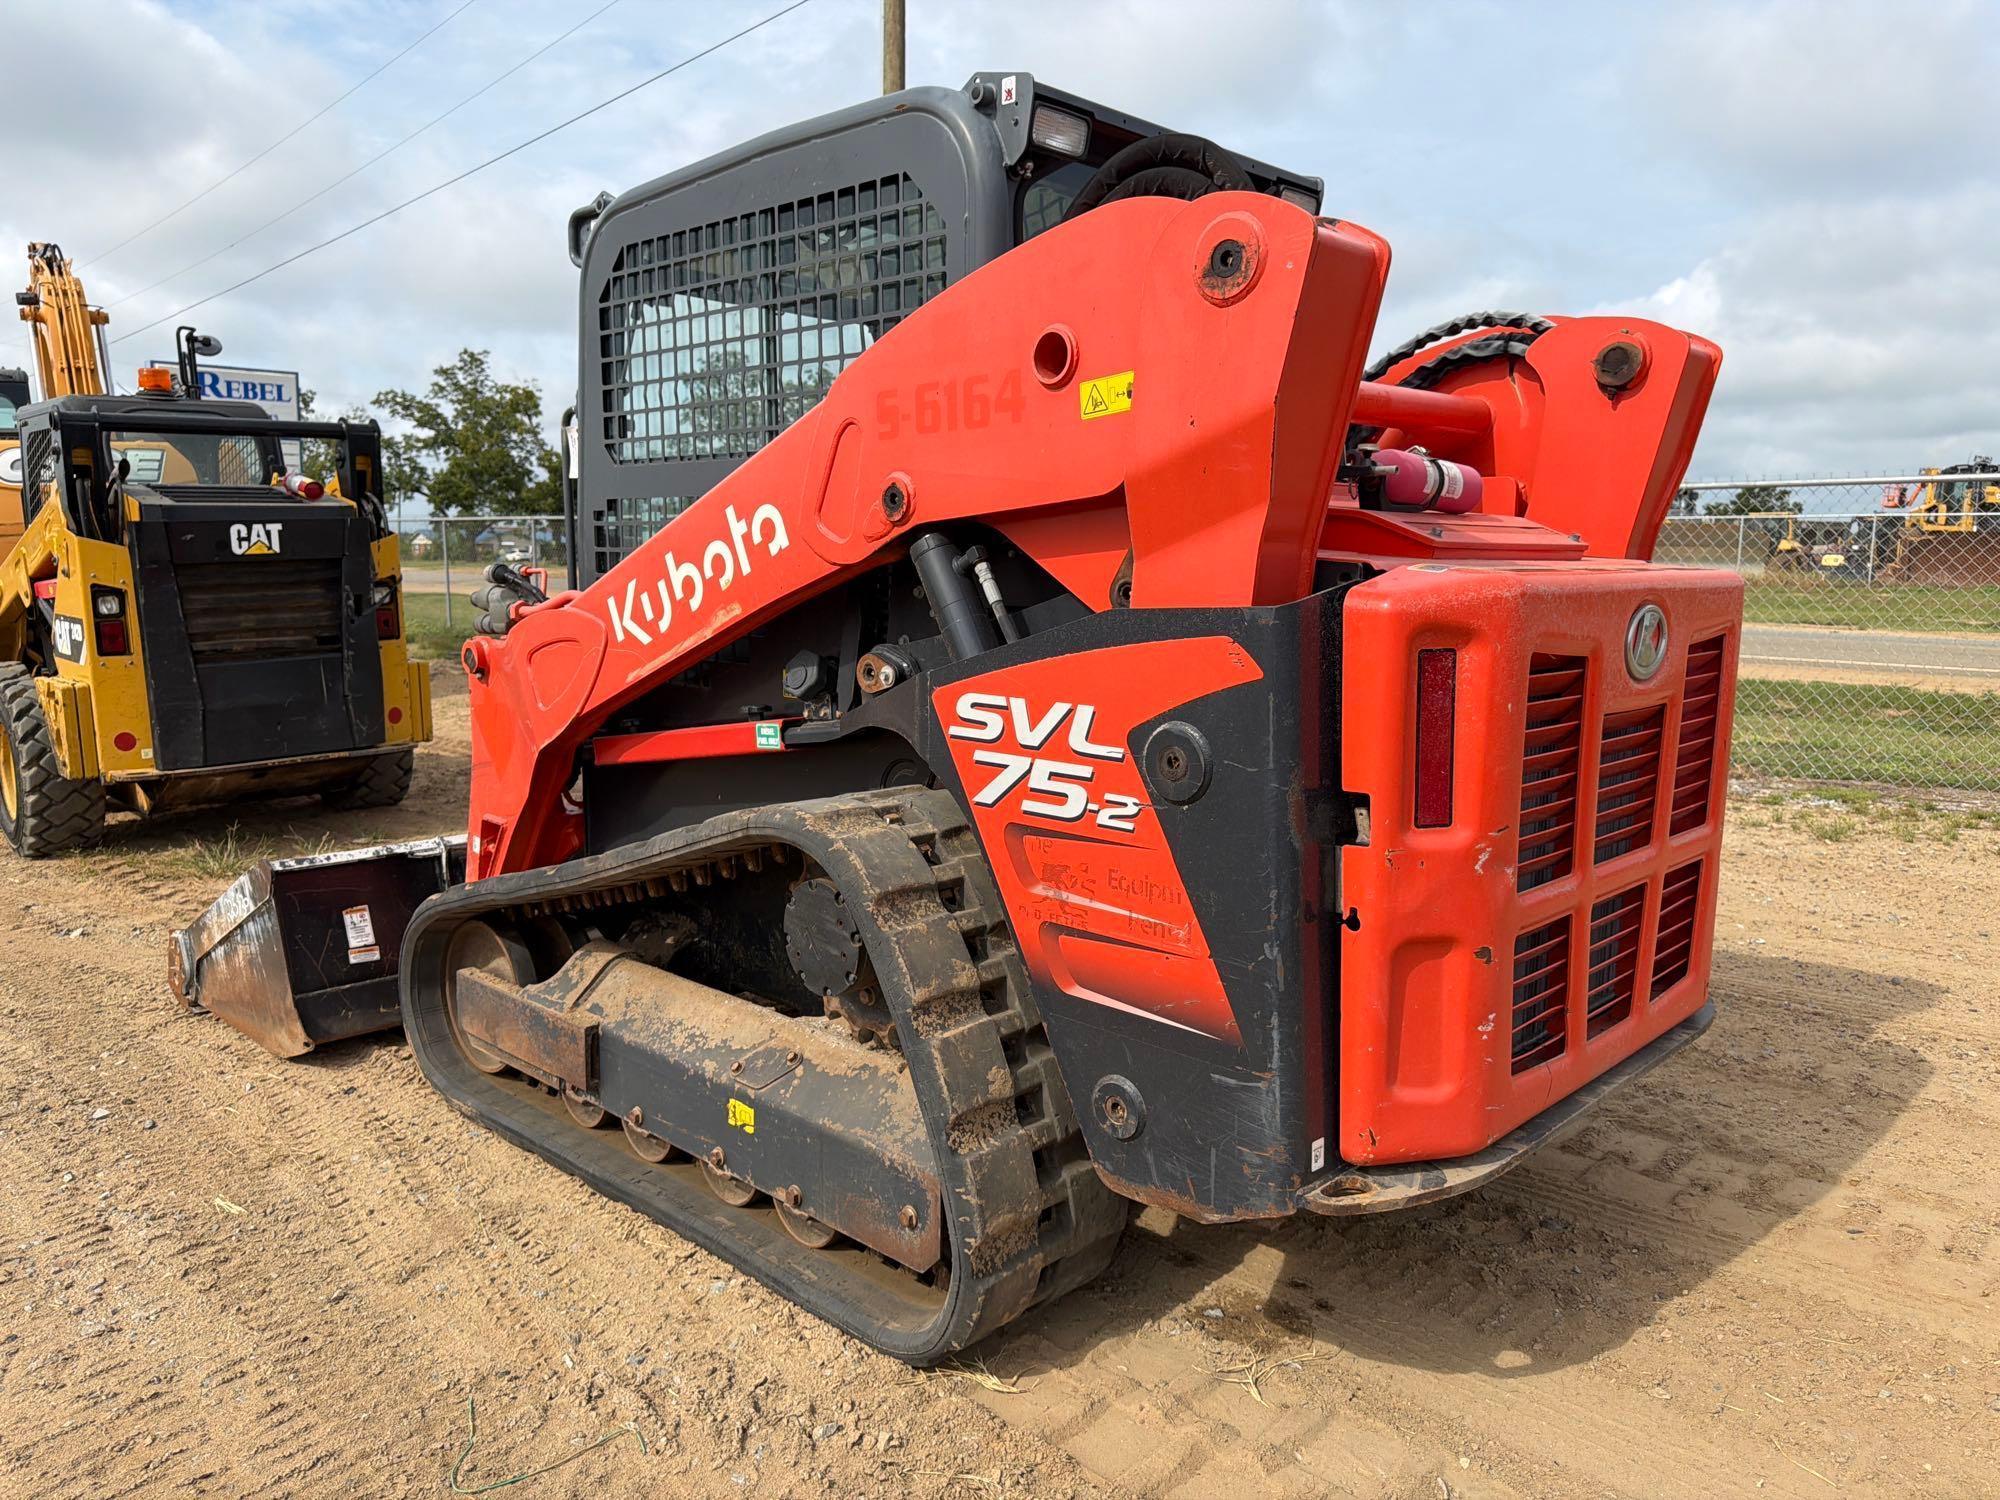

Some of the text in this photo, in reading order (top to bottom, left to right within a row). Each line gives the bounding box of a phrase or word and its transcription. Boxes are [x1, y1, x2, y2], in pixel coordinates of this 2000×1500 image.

[197, 371, 292, 403] REBEL
[876, 368, 1027, 440] S-6164
[230, 523, 283, 555] CAT
[607, 503, 790, 645] Kubota
[948, 692, 1126, 763] SVL
[972, 749, 1137, 833] 75-2
